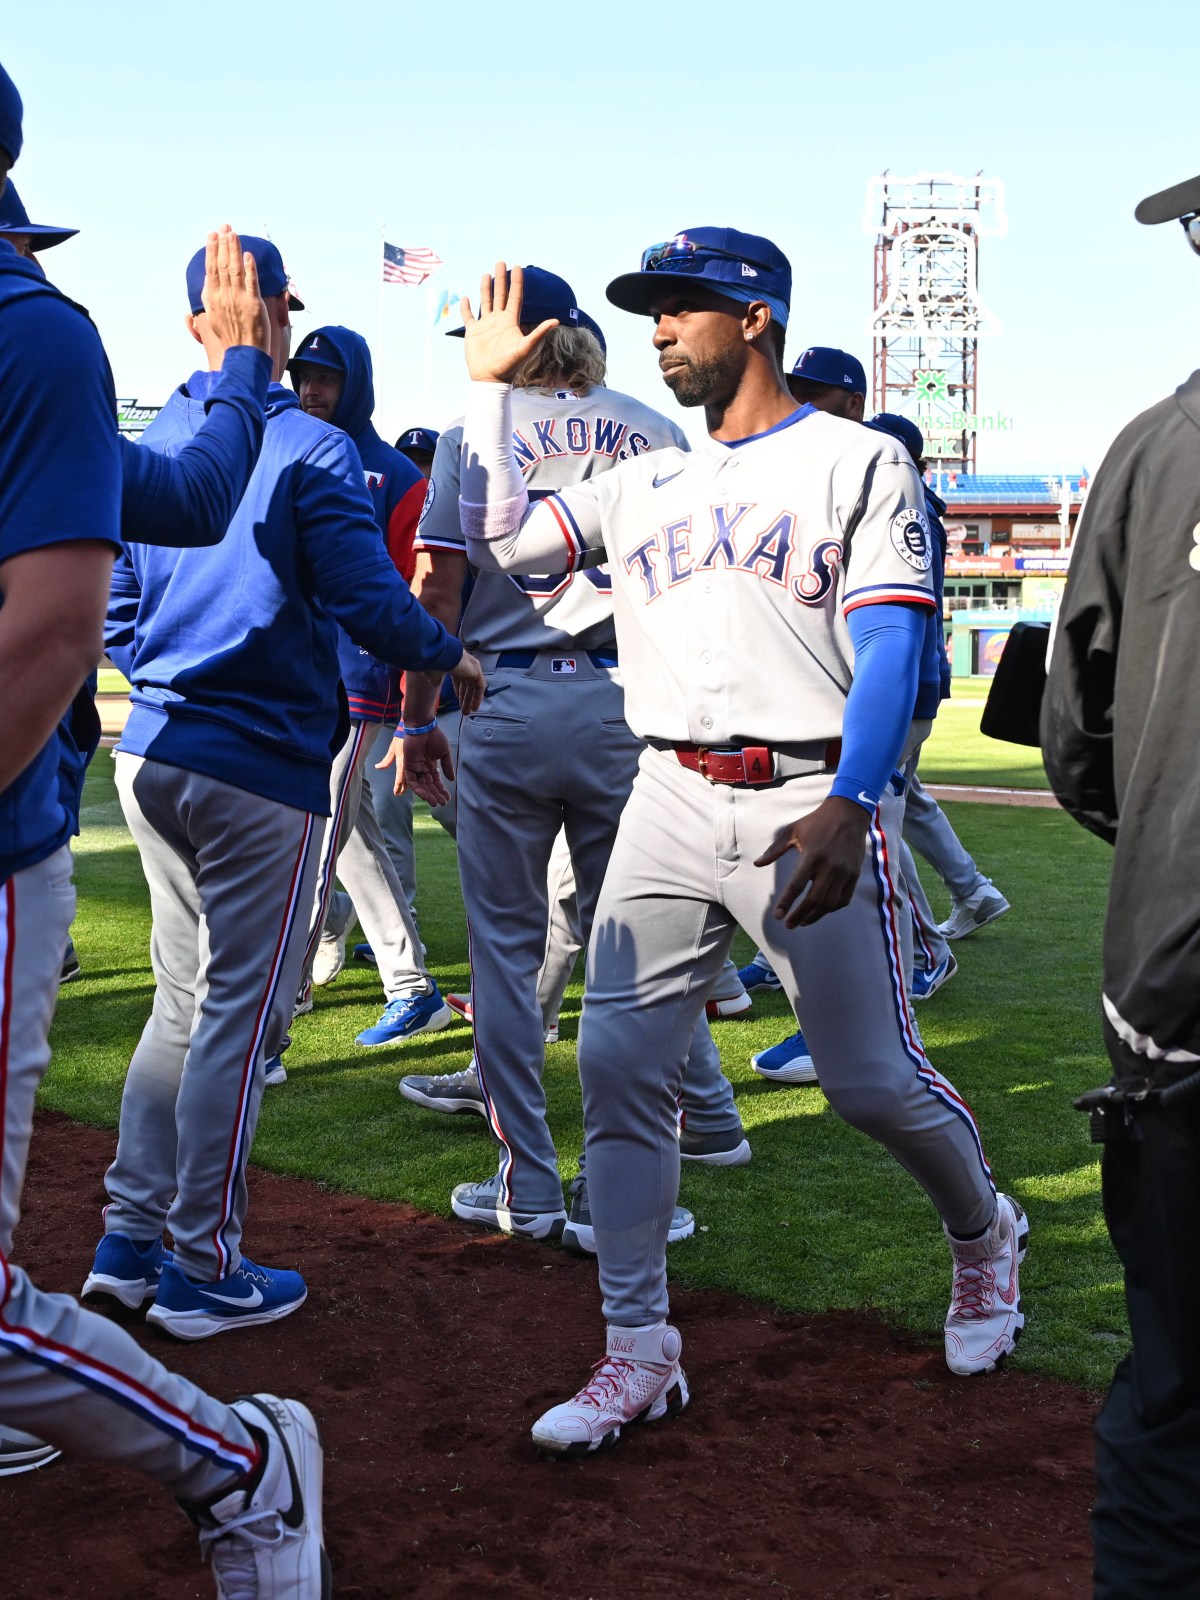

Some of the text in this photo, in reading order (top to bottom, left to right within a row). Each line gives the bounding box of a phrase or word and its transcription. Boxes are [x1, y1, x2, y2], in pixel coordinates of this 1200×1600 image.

[408, 430, 424, 446] T
[513, 416, 651, 473] NKOWS
[623, 502, 845, 606] TEXAS
[751, 756, 764, 775] 4
[608, 1336, 636, 1353] NIKE
